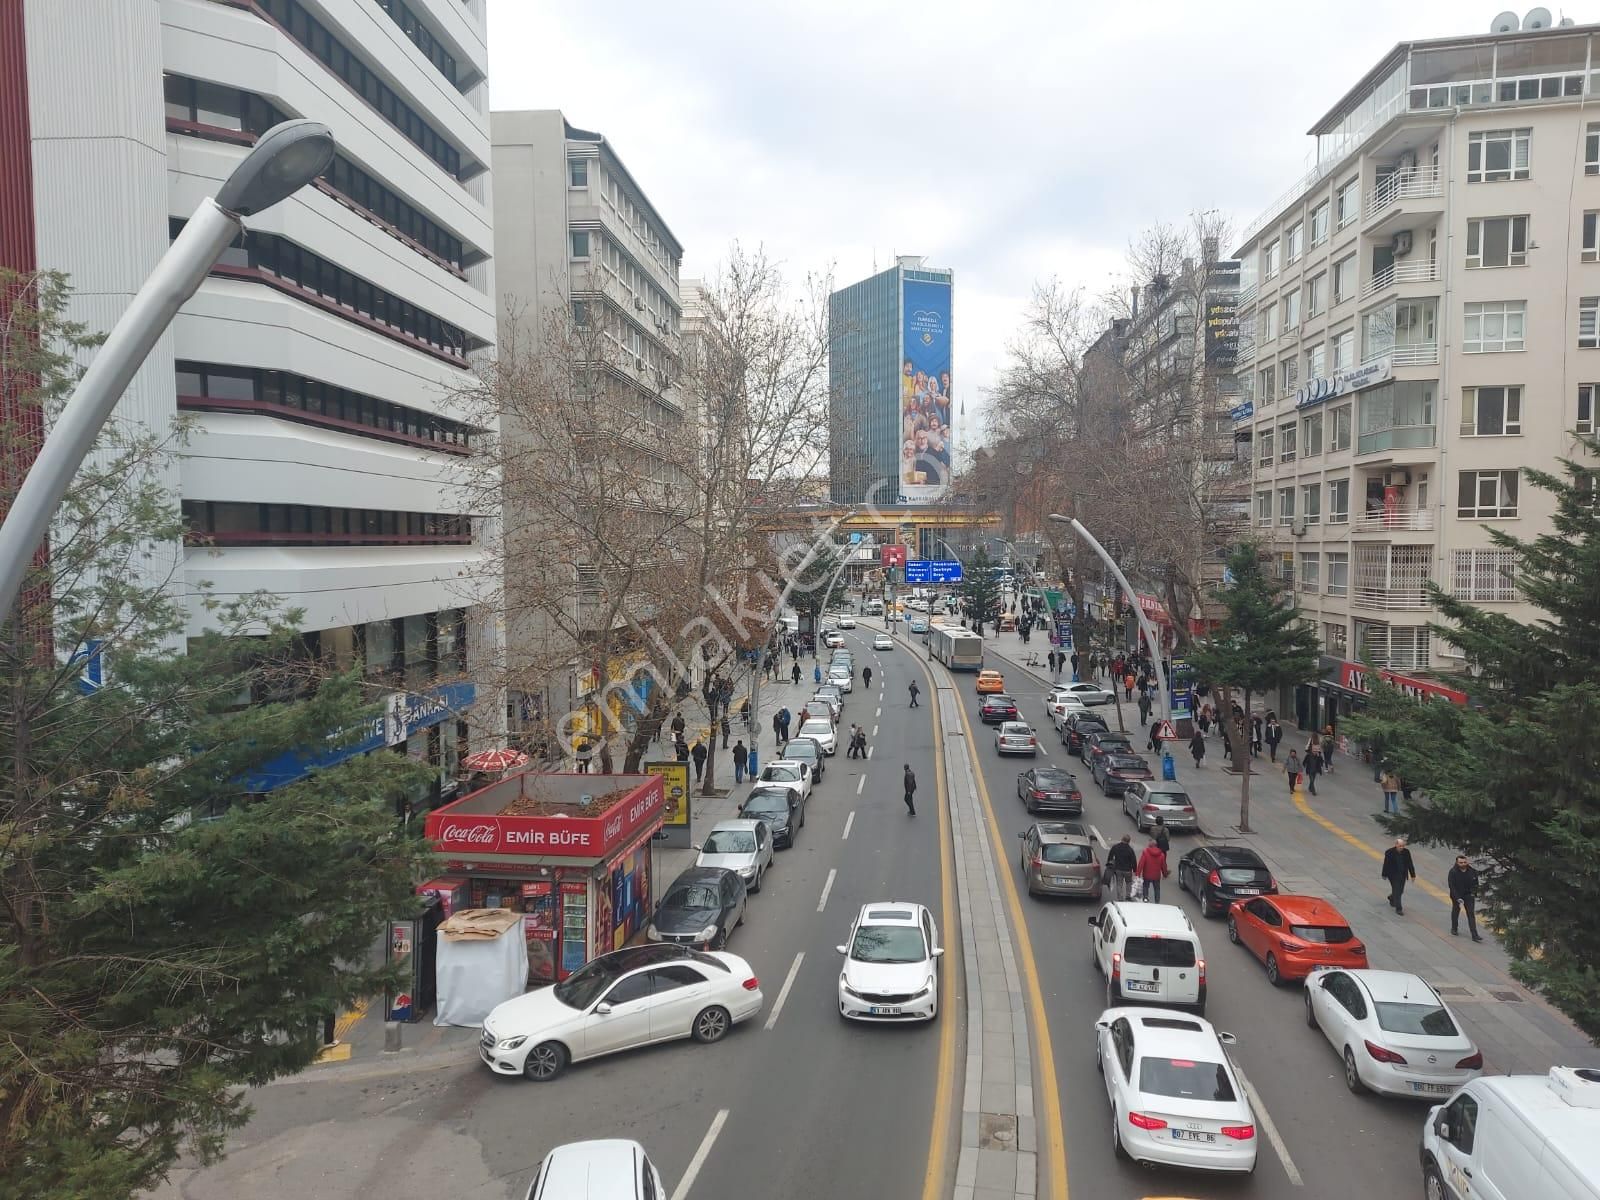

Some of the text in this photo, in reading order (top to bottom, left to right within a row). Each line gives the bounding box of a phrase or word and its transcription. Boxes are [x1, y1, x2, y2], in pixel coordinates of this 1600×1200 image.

[630, 800, 645, 823] EMİR
[646, 789, 659, 811] BÜFE
[443, 824, 590, 846] Coca-Cola EMİR BÜFE
